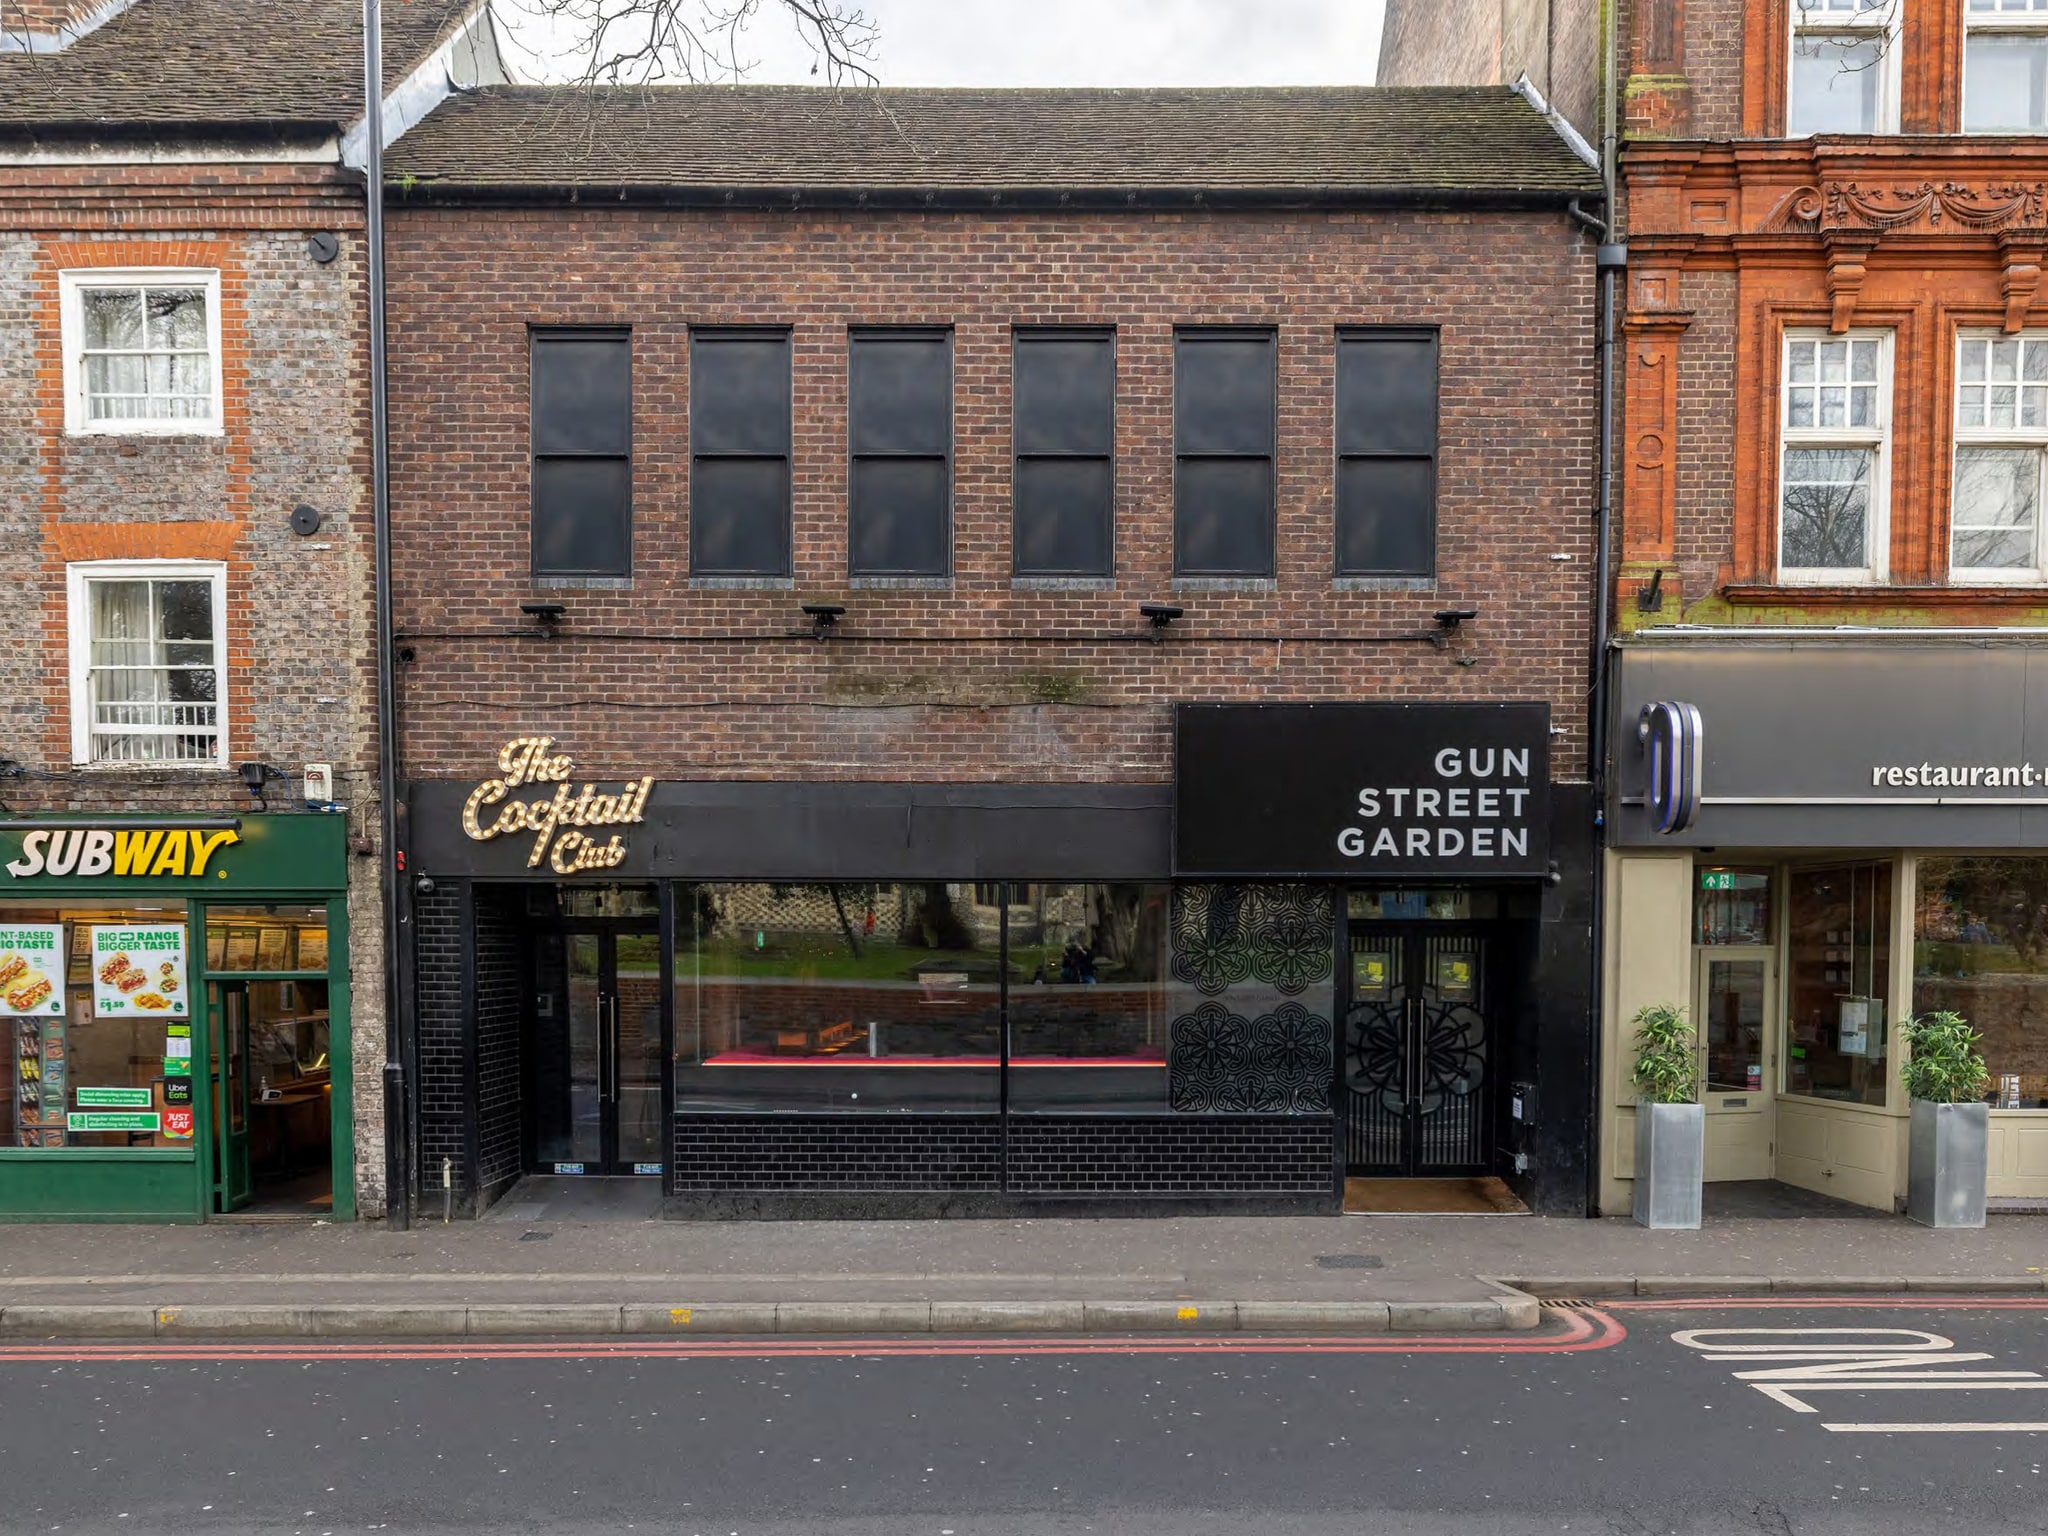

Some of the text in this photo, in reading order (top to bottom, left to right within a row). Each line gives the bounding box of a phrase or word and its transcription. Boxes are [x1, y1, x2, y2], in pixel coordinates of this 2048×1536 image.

[498, 736, 576, 787] The
[1434, 748, 1529, 777] GUN
[1358, 788, 1530, 817] STREET
[462, 775, 655, 868] Cocktail
[551, 830, 626, 874] Club
[1337, 827, 1528, 857] GARDEN
[5, 829, 239, 878] SUBWAY
[16, 940, 54, 949] TASTE
[97, 932, 117, 942] BIG
[137, 931, 179, 941] RANGE
[98, 940, 180, 951] BIGGER TASTE
[168, 1084, 188, 1092] Uber
[168, 1091, 188, 1099] Eats
[167, 1113, 190, 1122] JUST
[172, 1121, 189, 1129] EAT
